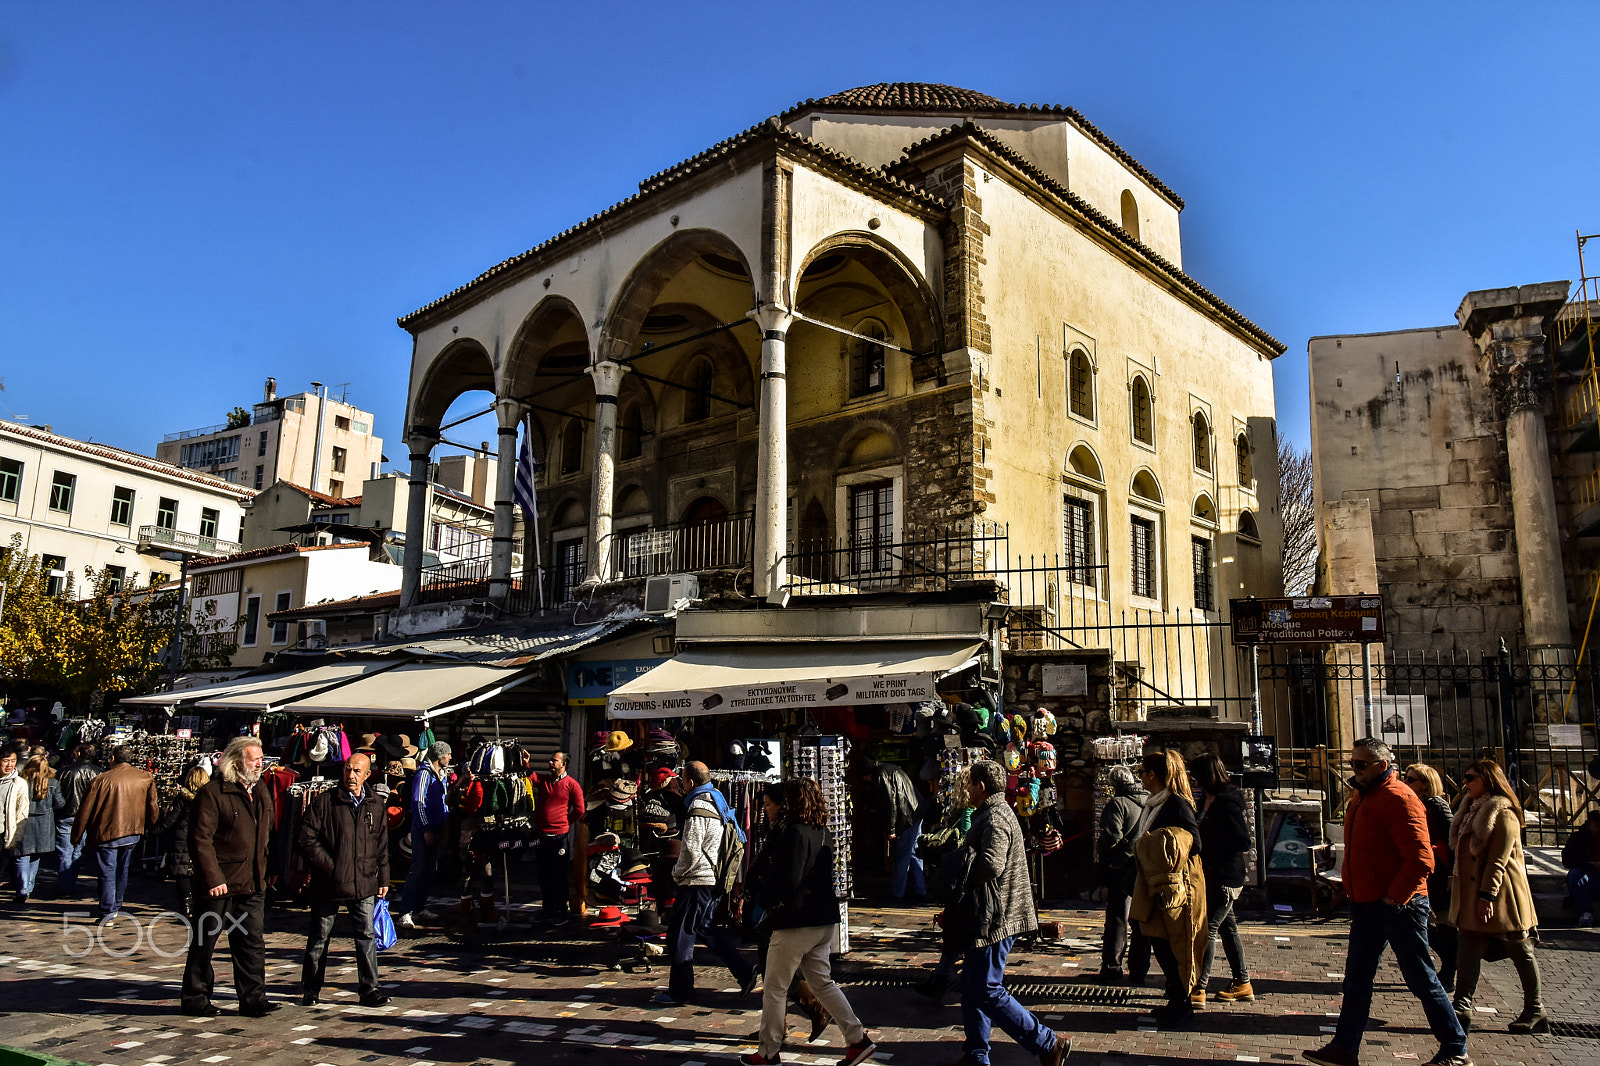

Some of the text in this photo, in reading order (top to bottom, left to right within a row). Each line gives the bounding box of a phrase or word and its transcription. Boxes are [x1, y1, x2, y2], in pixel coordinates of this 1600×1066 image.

[1262, 621, 1300, 630] Mosque
[1263, 630, 1315, 638] Traditional
[873, 680, 907, 689] WE PRINT
[775, 693, 816, 704] ΤΑΥΤΟΤΗΤΕΣ
[856, 687, 926, 700] MILITARY DOG TAGS
[613, 700, 657, 711] SOUVENIRS
[662, 698, 692, 709] KNIVES
